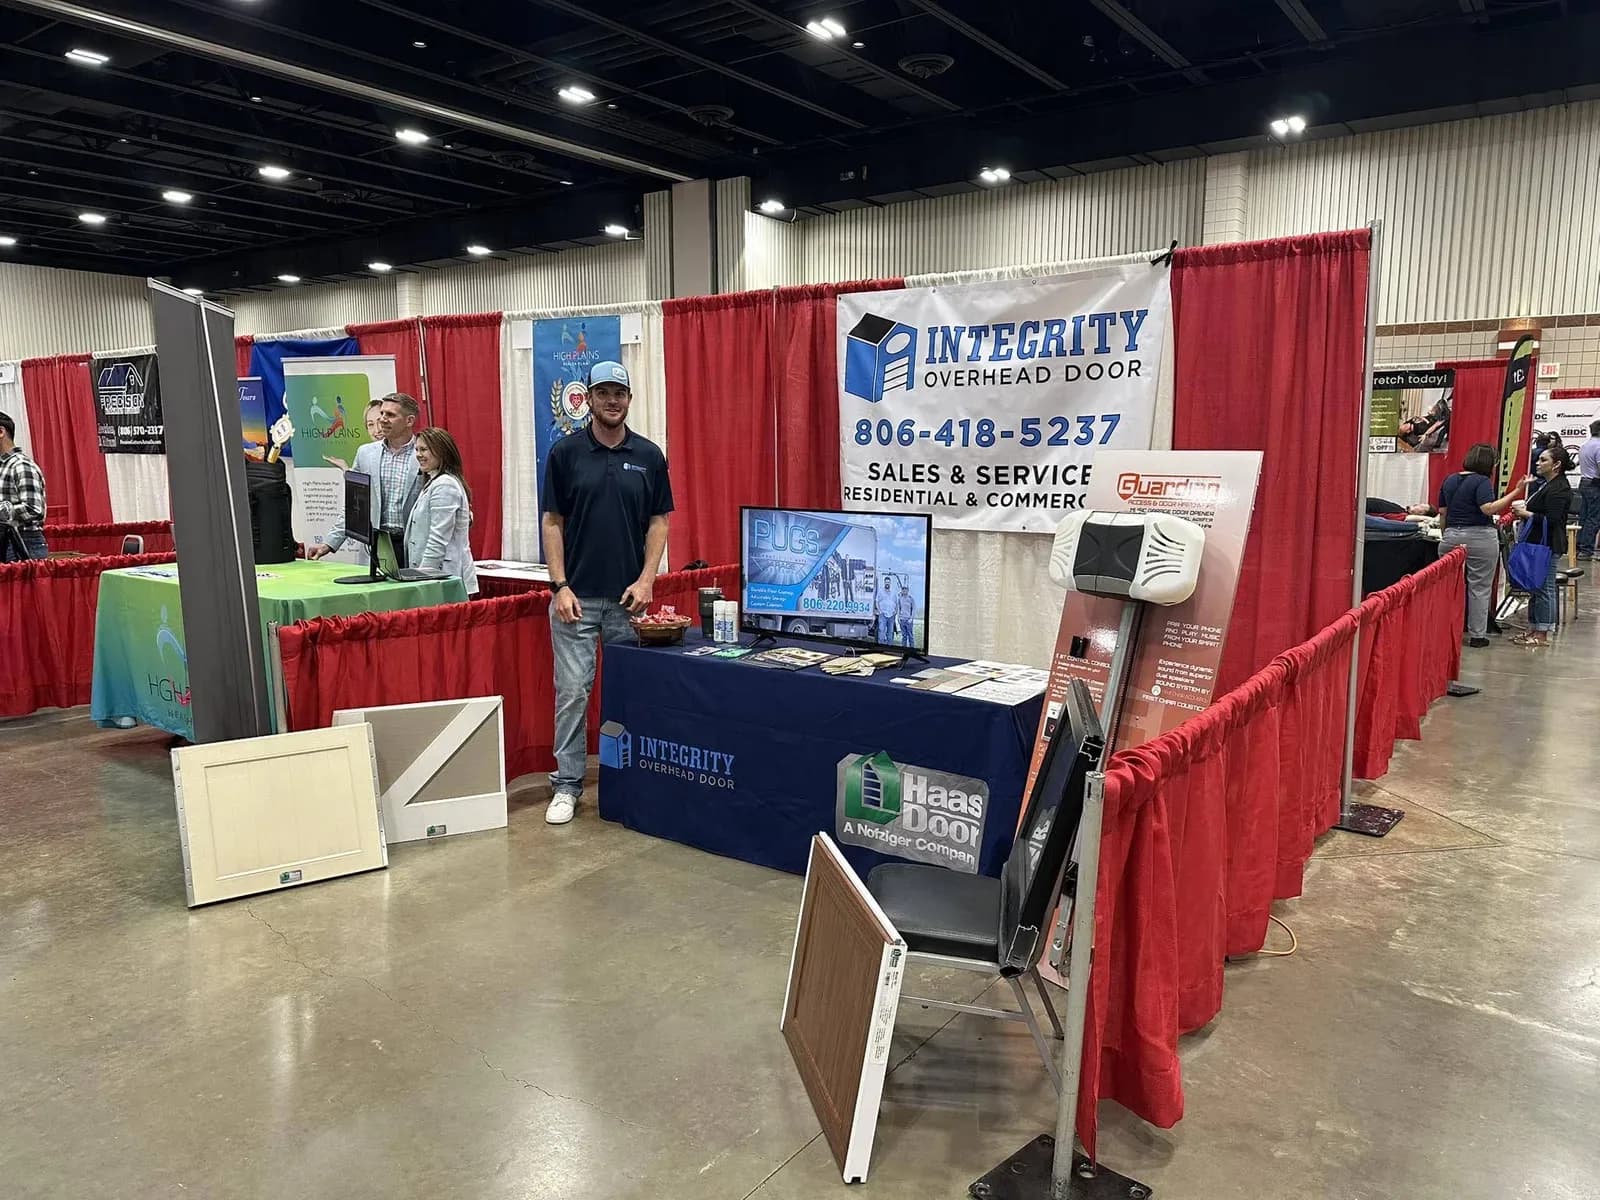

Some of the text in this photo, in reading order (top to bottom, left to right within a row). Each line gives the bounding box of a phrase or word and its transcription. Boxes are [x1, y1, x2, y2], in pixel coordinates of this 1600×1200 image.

[925, 309, 1148, 364] INTEGRITY
[553, 350, 599, 360] HIGH PLAINS
[924, 360, 1142, 388] OVERHEAD DOOR
[1374, 374, 1447, 385] retch today!
[238, 386, 256, 400] Tours
[855, 414, 1120, 448] 806-418-5237
[868, 462, 1092, 485] SALES & SERVICE
[844, 486, 1086, 509] RESIDENTIAL & COMMERC
[754, 520, 820, 556] PUGS
[803, 598, 870, 612] 806.220.9934
[1201, 626, 1222, 634] PHONE
[1158, 659, 1214, 674] Experience dynamic
[1156, 680, 1175, 688] SOUND
[1176, 683, 1201, 693] SYSTEM
[639, 736, 735, 776] INTEGRITY
[639, 759, 735, 790] OVERHEAD DOOR
[903, 772, 983, 818] Haas
[903, 803, 980, 848] Door
[842, 821, 975, 864] A Nofziger Compan
